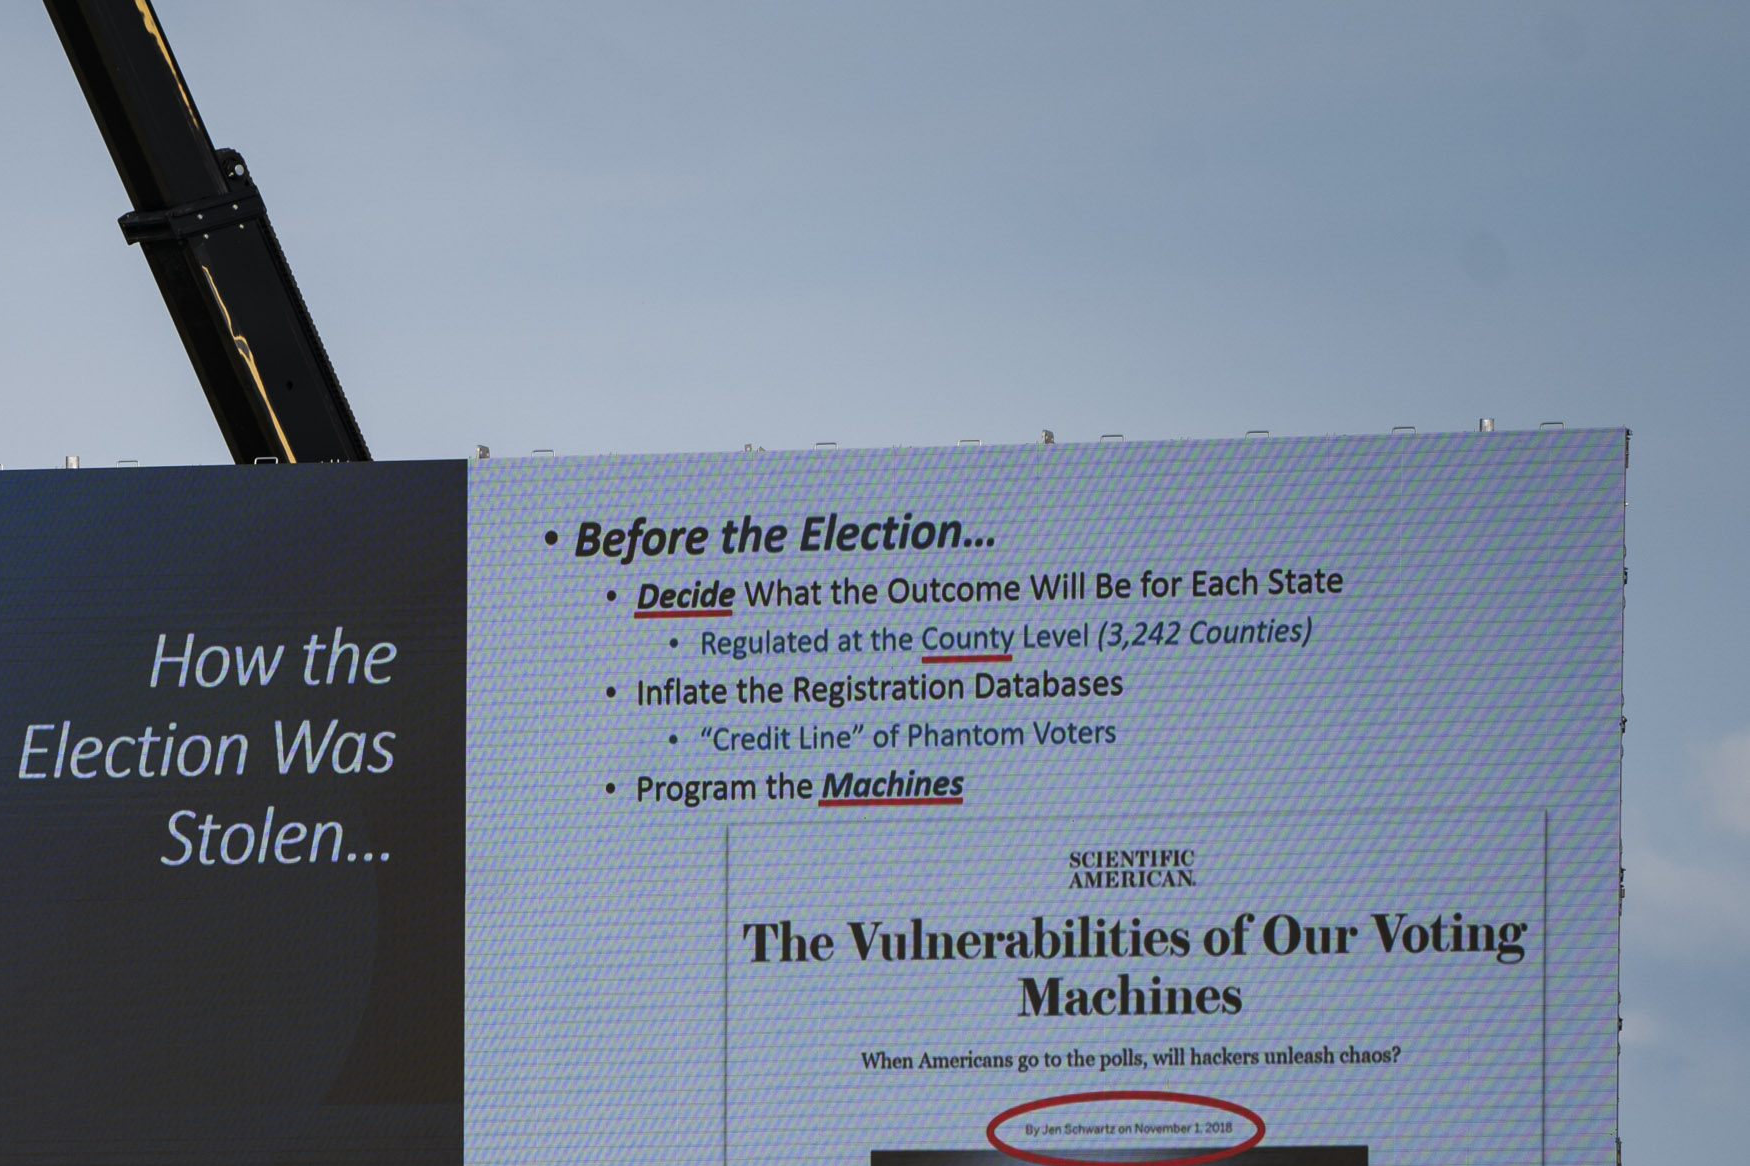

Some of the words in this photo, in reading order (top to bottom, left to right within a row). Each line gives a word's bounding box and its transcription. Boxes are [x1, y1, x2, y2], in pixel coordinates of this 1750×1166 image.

[575, 517, 708, 565] Before
[722, 515, 787, 554] the
[800, 513, 995, 551] Election...
[637, 580, 735, 609] Decide
[745, 580, 822, 607] What
[831, 577, 878, 605] the
[888, 578, 1020, 604] Outcome
[1030, 572, 1085, 600] Will
[1096, 573, 1131, 599] Be
[1140, 570, 1182, 598] for
[1192, 568, 1258, 597] Each
[1268, 568, 1343, 595] State
[149, 632, 286, 688] How
[303, 626, 397, 686] the
[701, 628, 829, 660] Regulated
[838, 631, 862, 653] at
[870, 626, 913, 651] the
[922, 626, 1014, 655] County
[1023, 623, 1088, 648] Level
[1098, 621, 1180, 652] (3,242
[1189, 616, 1312, 648] Counties)
[637, 677, 727, 706] Inflate
[736, 676, 783, 703] the
[793, 674, 964, 708] Registration
[975, 670, 1123, 699] Databases
[18, 720, 249, 781] Election
[273, 718, 397, 776] Was
[873, 723, 900, 748] of
[908, 722, 1024, 747] Phantom
[1033, 721, 1116, 745] Voters
[637, 775, 756, 808] Program
[766, 772, 813, 800] the
[822, 770, 963, 799] Machines
[160, 806, 392, 867] Stolen...
[1069, 850, 1195, 869] SCIENTIFIC
[743, 920, 835, 963] The
[847, 915, 1190, 961] Vulnerabilities
[1203, 913, 1255, 957] of
[1263, 914, 1358, 956] Our
[1370, 912, 1528, 965] Voting
[1018, 973, 1242, 1017] Machines
[861, 1051, 914, 1071] When
[918, 1050, 1013, 1070] Americans
[1018, 1053, 1039, 1073] go
[1043, 1051, 1062, 1068] to
[1067, 1049, 1096, 1068] the
[1100, 1047, 1148, 1072] polls,
[1152, 1047, 1186, 1067] will
[1190, 1046, 1259, 1066] hackers
[1264, 1046, 1335, 1065] unleash
[1339, 1045, 1402, 1064] chaos?
[1025, 1124, 1040, 1136] By
[1042, 1123, 1062, 1135] Jen
[1064, 1123, 1116, 1135] Schwartz
[1118, 1125, 1132, 1135] on
[1135, 1123, 1193, 1135] November
[1205, 1122, 1233, 1134] 2018
